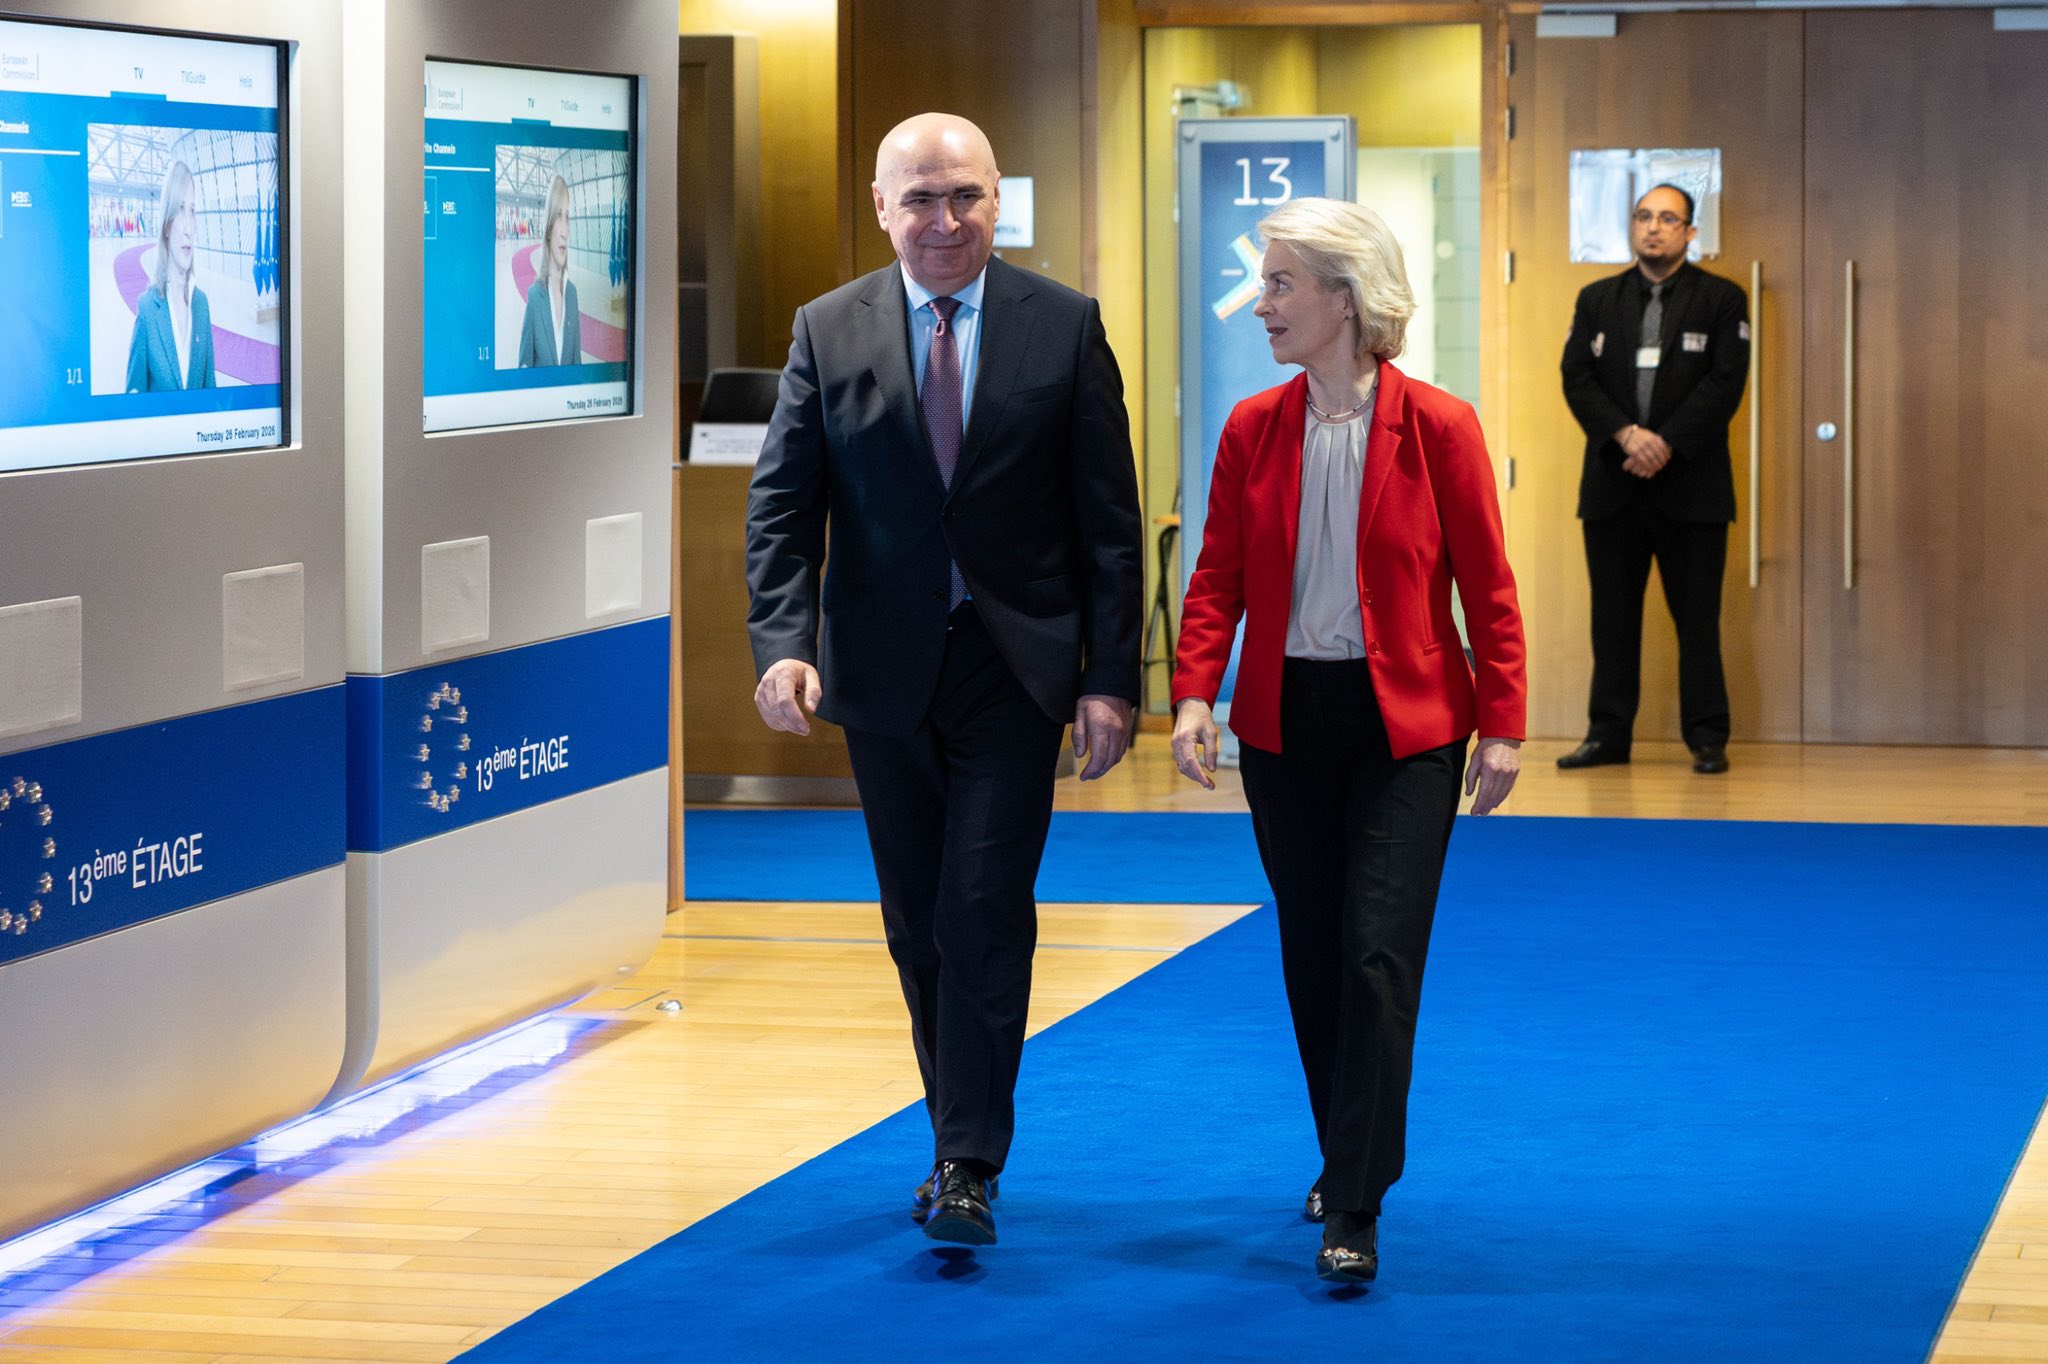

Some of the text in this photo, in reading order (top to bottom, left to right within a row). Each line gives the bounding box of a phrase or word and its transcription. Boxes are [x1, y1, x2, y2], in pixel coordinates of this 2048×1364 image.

[133, 66, 144, 80] TV
[239, 75, 253, 89] Help
[527, 97, 535, 109] TV
[1233, 157, 1293, 206] 13
[478, 346, 489, 361] 1/1
[66, 367, 83, 386] 1/1
[196, 425, 276, 443] Thursday 26 February 2026
[475, 735, 569, 792] 13ème ÉTAGE
[68, 832, 203, 906] 13ème ÉTAGE
